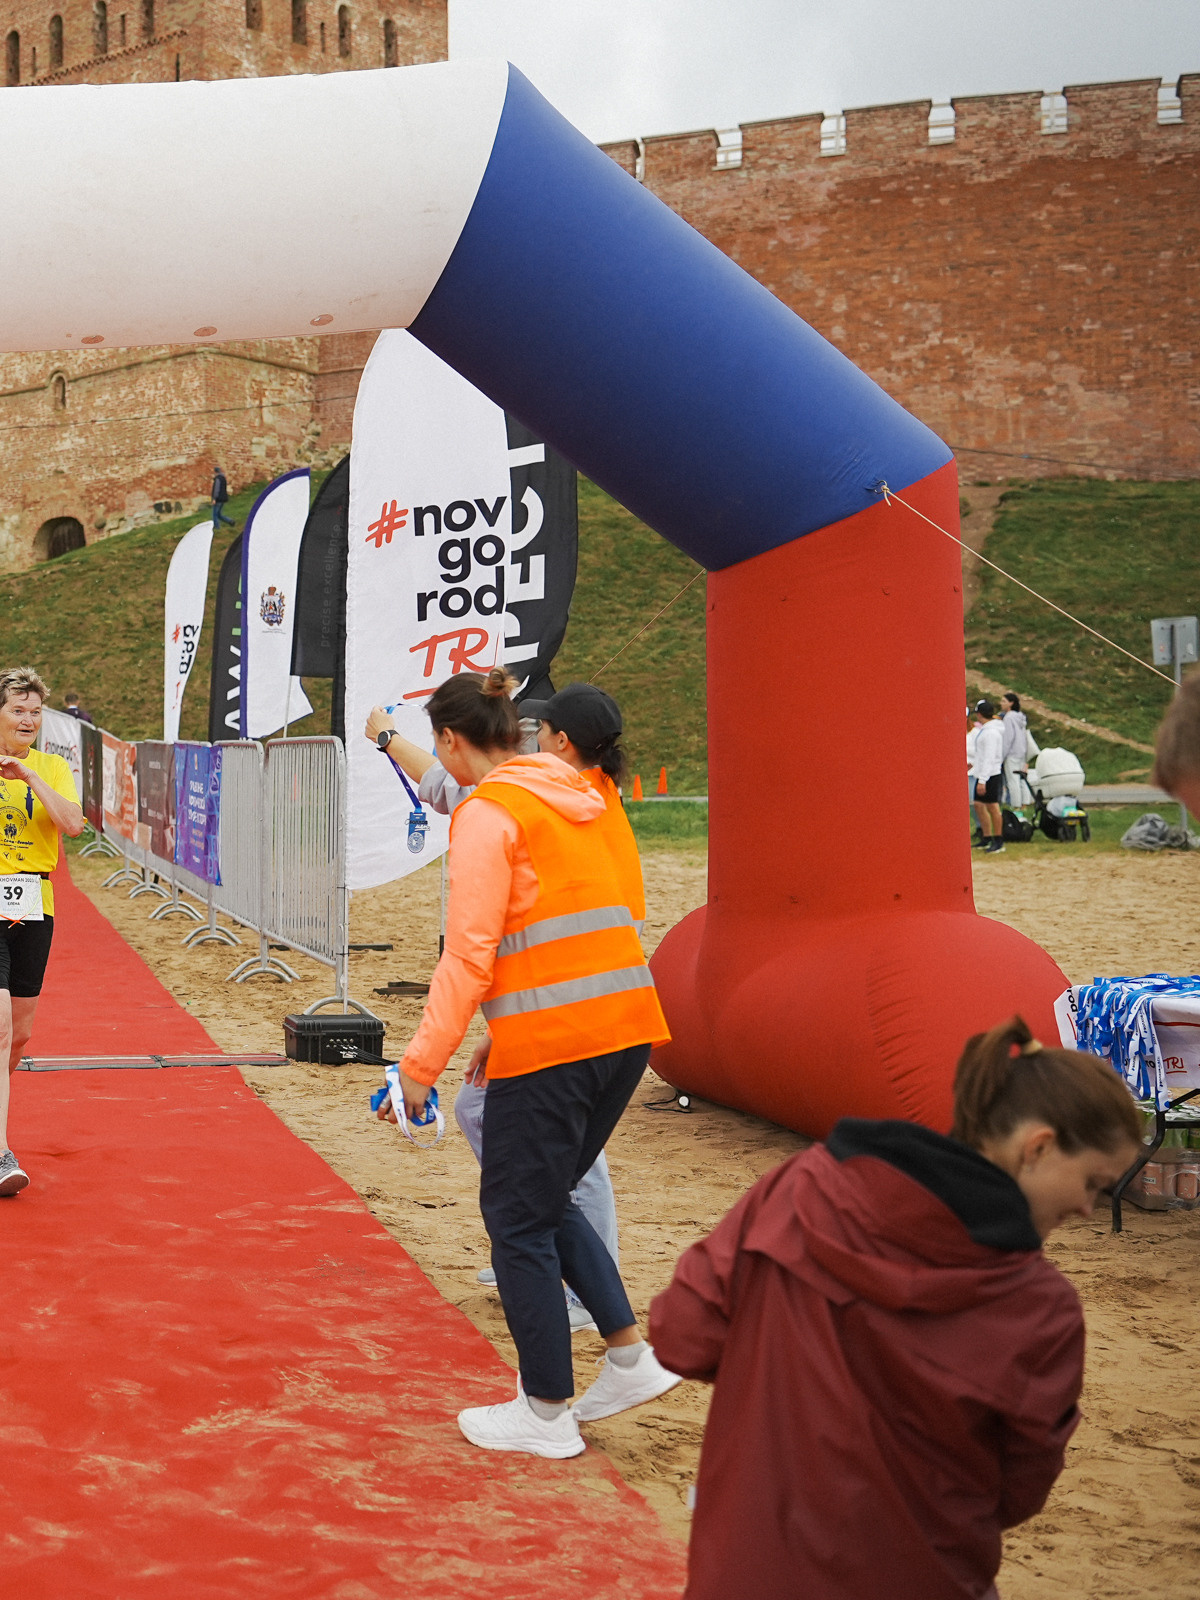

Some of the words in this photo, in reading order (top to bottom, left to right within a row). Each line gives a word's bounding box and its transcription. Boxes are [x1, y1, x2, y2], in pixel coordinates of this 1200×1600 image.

[365, 495, 507, 548] #nov
[324, 524, 341, 594] excellence
[438, 534, 506, 583] go
[416, 565, 505, 622] rod
[321, 600, 331, 647] precise
[3, 886, 24, 900] 39
